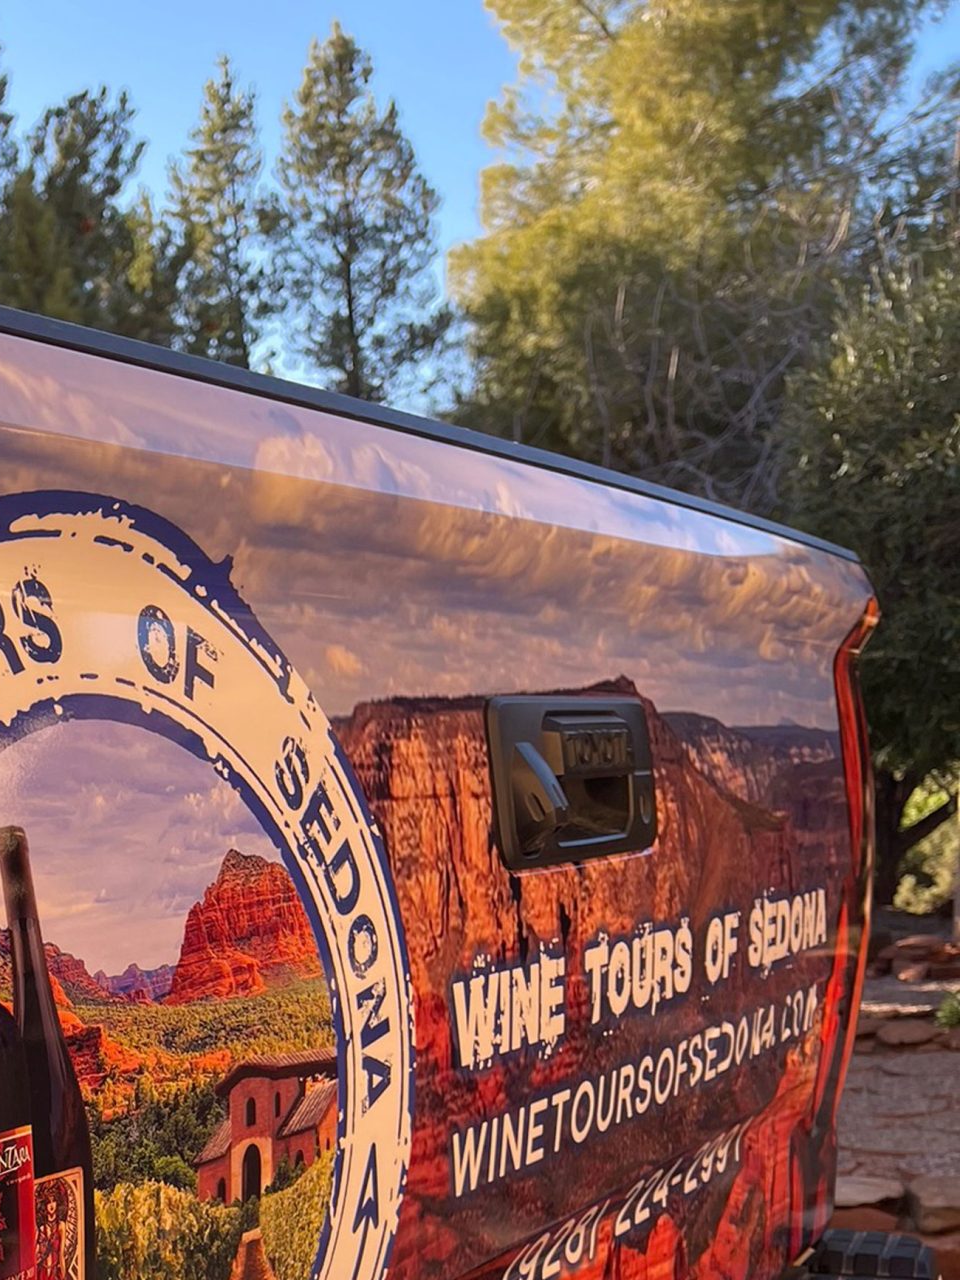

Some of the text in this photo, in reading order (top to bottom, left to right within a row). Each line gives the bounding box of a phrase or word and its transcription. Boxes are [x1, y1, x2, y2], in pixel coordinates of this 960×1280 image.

[137, 603, 224, 699] OF
[274, 735, 392, 1117] SEDONA
[453, 890, 827, 1070] WINE TOURS OF SEDONA
